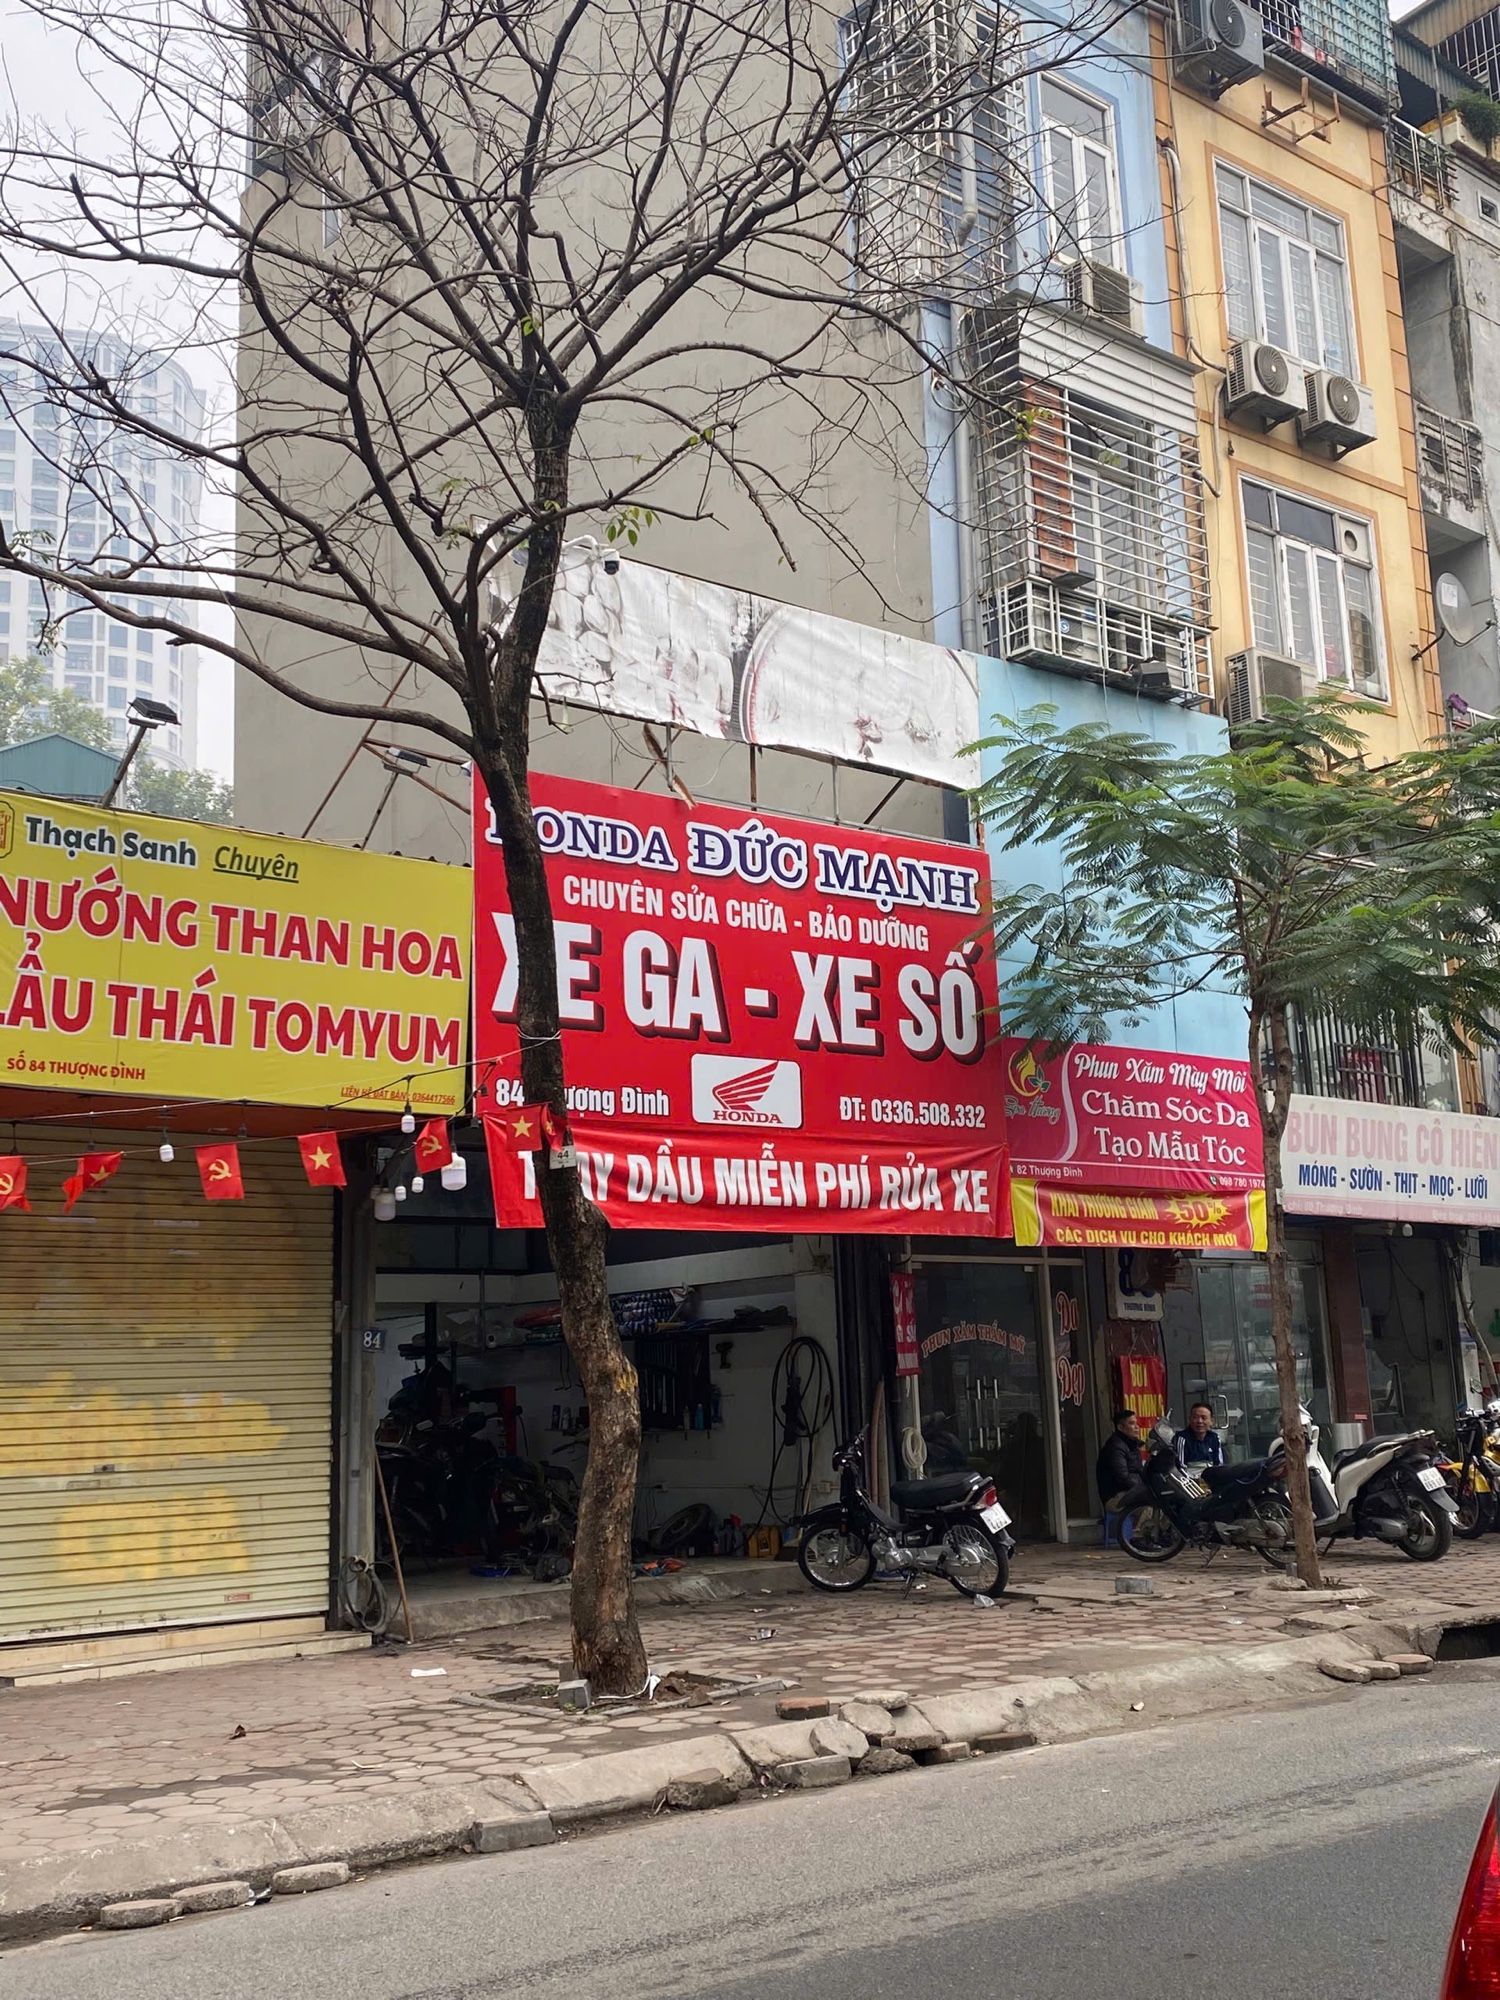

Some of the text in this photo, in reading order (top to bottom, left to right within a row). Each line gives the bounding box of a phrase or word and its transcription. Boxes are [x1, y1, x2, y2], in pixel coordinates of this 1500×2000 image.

[25, 816, 300, 883] Thạch Sanh Chuyên
[687, 818, 808, 889] ĐỨC
[815, 843, 981, 914] MẠNH
[563, 874, 663, 918] CHUYÊN
[671, 884, 718, 923] SỬA
[725, 895, 787, 935] CHỮA
[808, 904, 853, 943] BẢO
[858, 917, 929, 952] DƯỠNG
[210, 903, 349, 966] THAN
[361, 924, 464, 980] HOA
[0, 932, 462, 1066] ẨU THÁI TOMYUM
[622, 928, 732, 1043] GA
[793, 950, 884, 1054] XE
[898, 941, 988, 1064] SỐ
[7, 1050, 146, 1081] SỐ 84 THƯỢNG ĐÌNH
[1074, 1052, 1119, 1080] Phun
[1125, 1058, 1166, 1084] Xăm
[1211, 1067, 1247, 1094] Môi
[496, 1078, 525, 1107] 84
[621, 1086, 670, 1116] Đình
[840, 1097, 986, 1129] ĐT: 0336.508.332
[1082, 1089, 1251, 1128] Chăm Sóc Da
[713, 1110, 783, 1124] HONDA
[1287, 1104, 1338, 1156] BÚN
[1346, 1116, 1409, 1164] BUNG
[1416, 1118, 1444, 1167] CÔ
[1093, 1127, 1247, 1166] Tạo Mẫu Tóc
[627, 1138, 704, 1205] DẦU
[715, 1143, 807, 1209] MIỄN
[816, 1155, 870, 1209] PHÍ
[879, 1152, 944, 1213] RỬA
[951, 1169, 991, 1213] XE
[1016, 1164, 1028, 1175] 82
[1299, 1160, 1337, 1187] MÓNG
[1350, 1164, 1383, 1191] SƯỜN
[1394, 1172, 1418, 1198] THỊT
[1429, 1175, 1454, 1200] MỌC
[1465, 1175, 1488, 1199] LƯỠI
[1056, 1227, 1083, 1243] CÁC
[1085, 1230, 1117, 1246] DỊCH
[1140, 1231, 1166, 1245] CHO
[1169, 1227, 1210, 1247] KHÁCH
[363, 1330, 382, 1348] 84
[921, 1328, 951, 1358] PHUN
